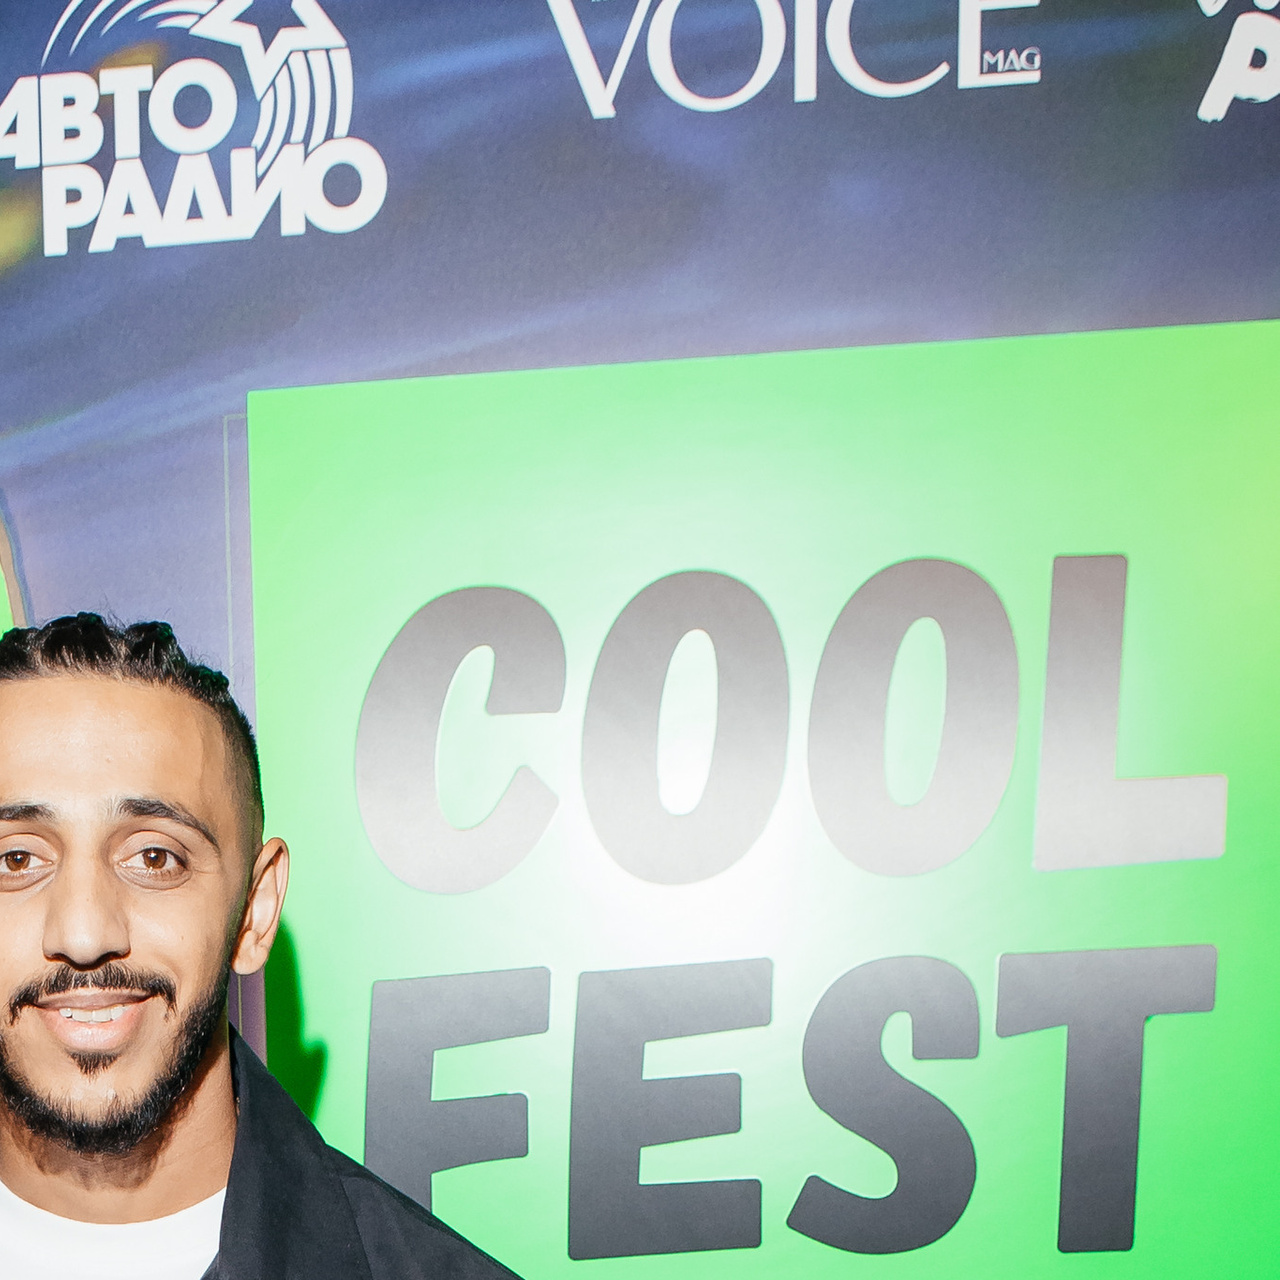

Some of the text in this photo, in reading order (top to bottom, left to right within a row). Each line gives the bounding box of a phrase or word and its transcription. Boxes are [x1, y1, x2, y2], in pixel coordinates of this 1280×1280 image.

[982, 47, 1041, 73] MAG
[41, 136, 388, 257] РАДИО
[354, 553, 1228, 896] COOL
[364, 944, 1218, 1261] FEST
